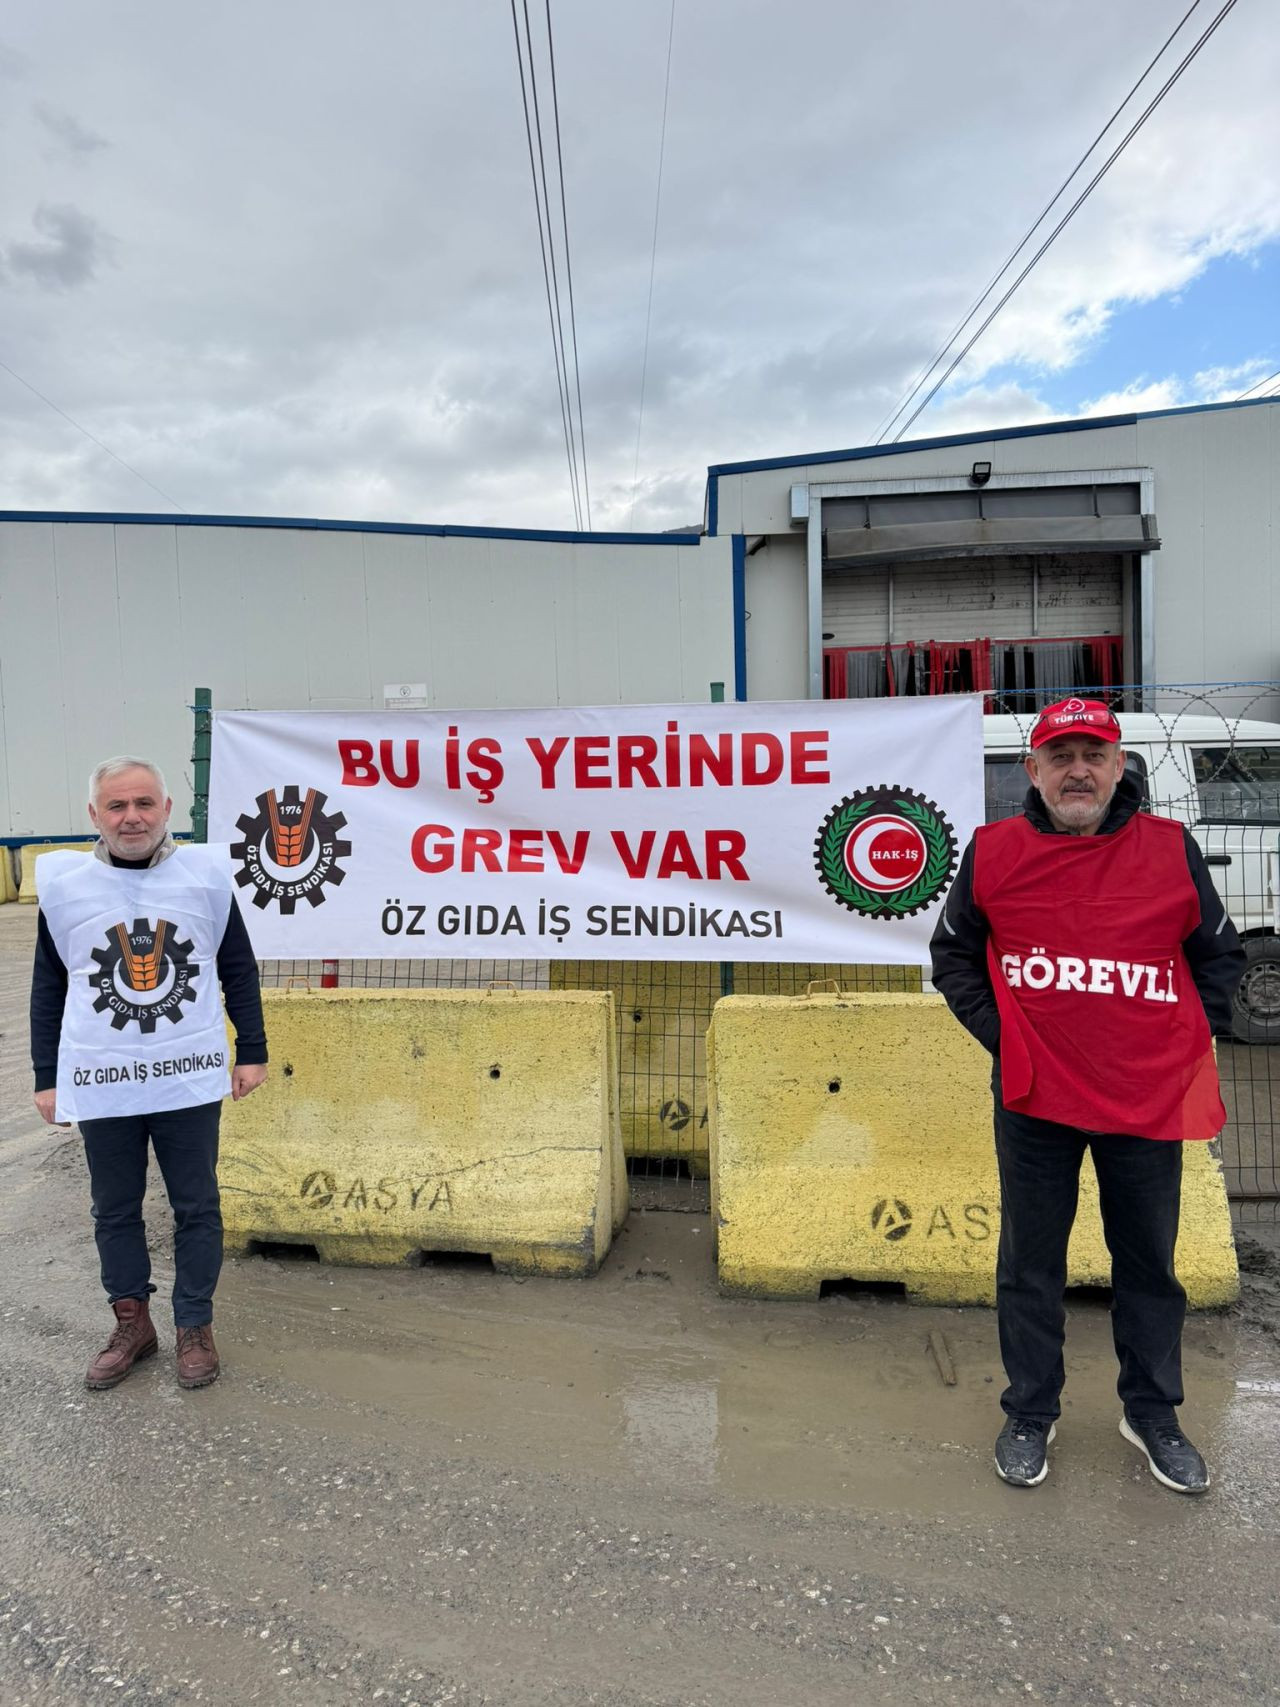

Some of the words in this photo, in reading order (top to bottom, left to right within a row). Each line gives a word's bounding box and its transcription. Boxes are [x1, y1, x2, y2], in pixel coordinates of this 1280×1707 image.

[337, 739, 420, 789] BU
[446, 725, 504, 804] İŞ
[525, 720, 831, 790] YERİNDE
[279, 805, 302, 815] 1976
[246, 845, 260, 862] ÖZ
[287, 842, 333, 897] SENDİKASI
[411, 823, 591, 875] GREV
[610, 829, 751, 881] VAR
[872, 848, 919, 862] HAK-İŞ
[249, 864, 271, 892] GIDA
[272, 882, 285, 899] İŞ
[381, 898, 426, 936] ÖZ
[437, 904, 526, 936] GIDA
[538, 898, 571, 943] İŞ
[585, 902, 784, 938] SENDİKASI
[130, 935, 153, 946] 1976
[1001, 946, 1179, 1004] GÖREVLİ
[100, 978, 113, 995] ÖZ
[108, 995, 134, 1017] GIDA
[138, 1006, 148, 1020] İŞ
[150, 969, 188, 1016] SENDİKASI
[73, 1067, 91, 1087] ÖZ
[94, 1065, 131, 1085] GIDA
[133, 1060, 148, 1083] İŞ
[152, 1051, 225, 1078] SENDİKASI
[343, 1177, 454, 1212] ASYA
[926, 1204, 999, 1241] AS
